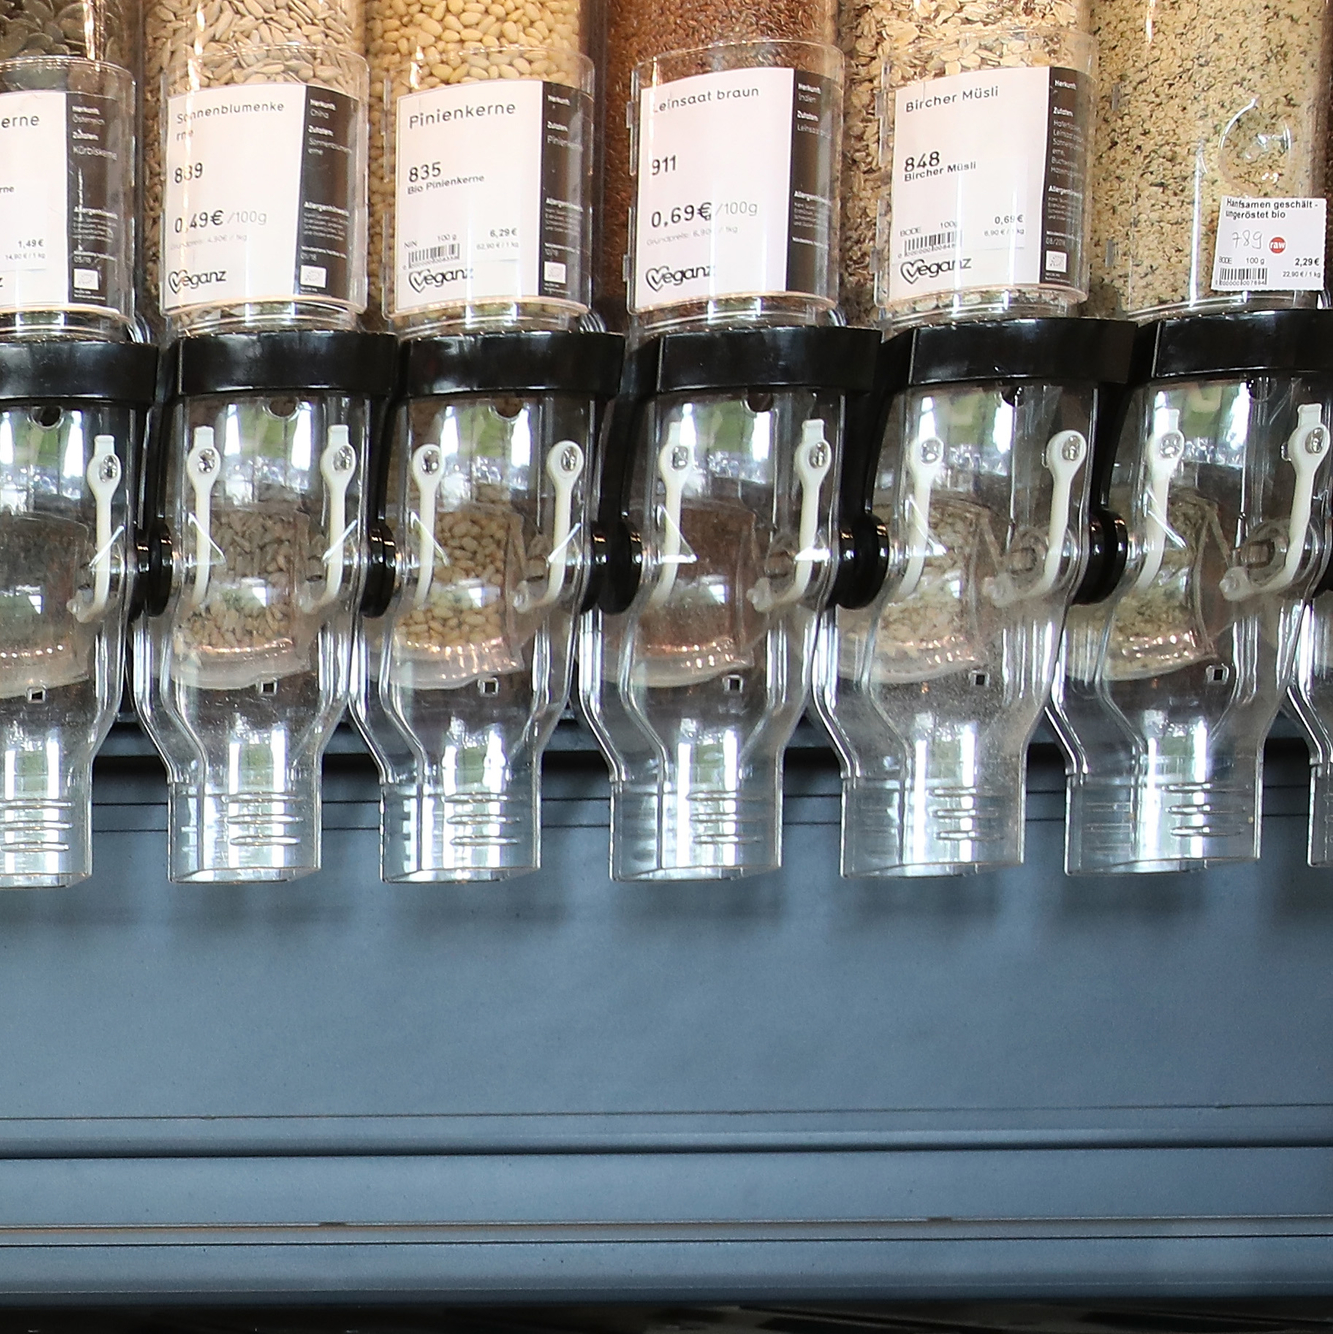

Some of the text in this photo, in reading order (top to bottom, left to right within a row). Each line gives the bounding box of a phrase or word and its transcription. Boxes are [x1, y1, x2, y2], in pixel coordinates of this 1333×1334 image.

[716, 87, 759, 100] braun
[906, 86, 999, 113] Bircher Müsli
[409, 102, 516, 130] Pinienkerne
[408, 162, 442, 183] 835
[651, 155, 677, 176] 911
[904, 151, 940, 173] 848
[904, 161, 977, 182] Bircher Müsli
[407, 174, 485, 195] Bio Pinienkerne
[1226, 198, 1312, 210] Hanfsamen geschält
[1272, 210, 1286, 218] bio
[227, 211, 267, 225] /100g
[1270, 240, 1286, 249] raw
